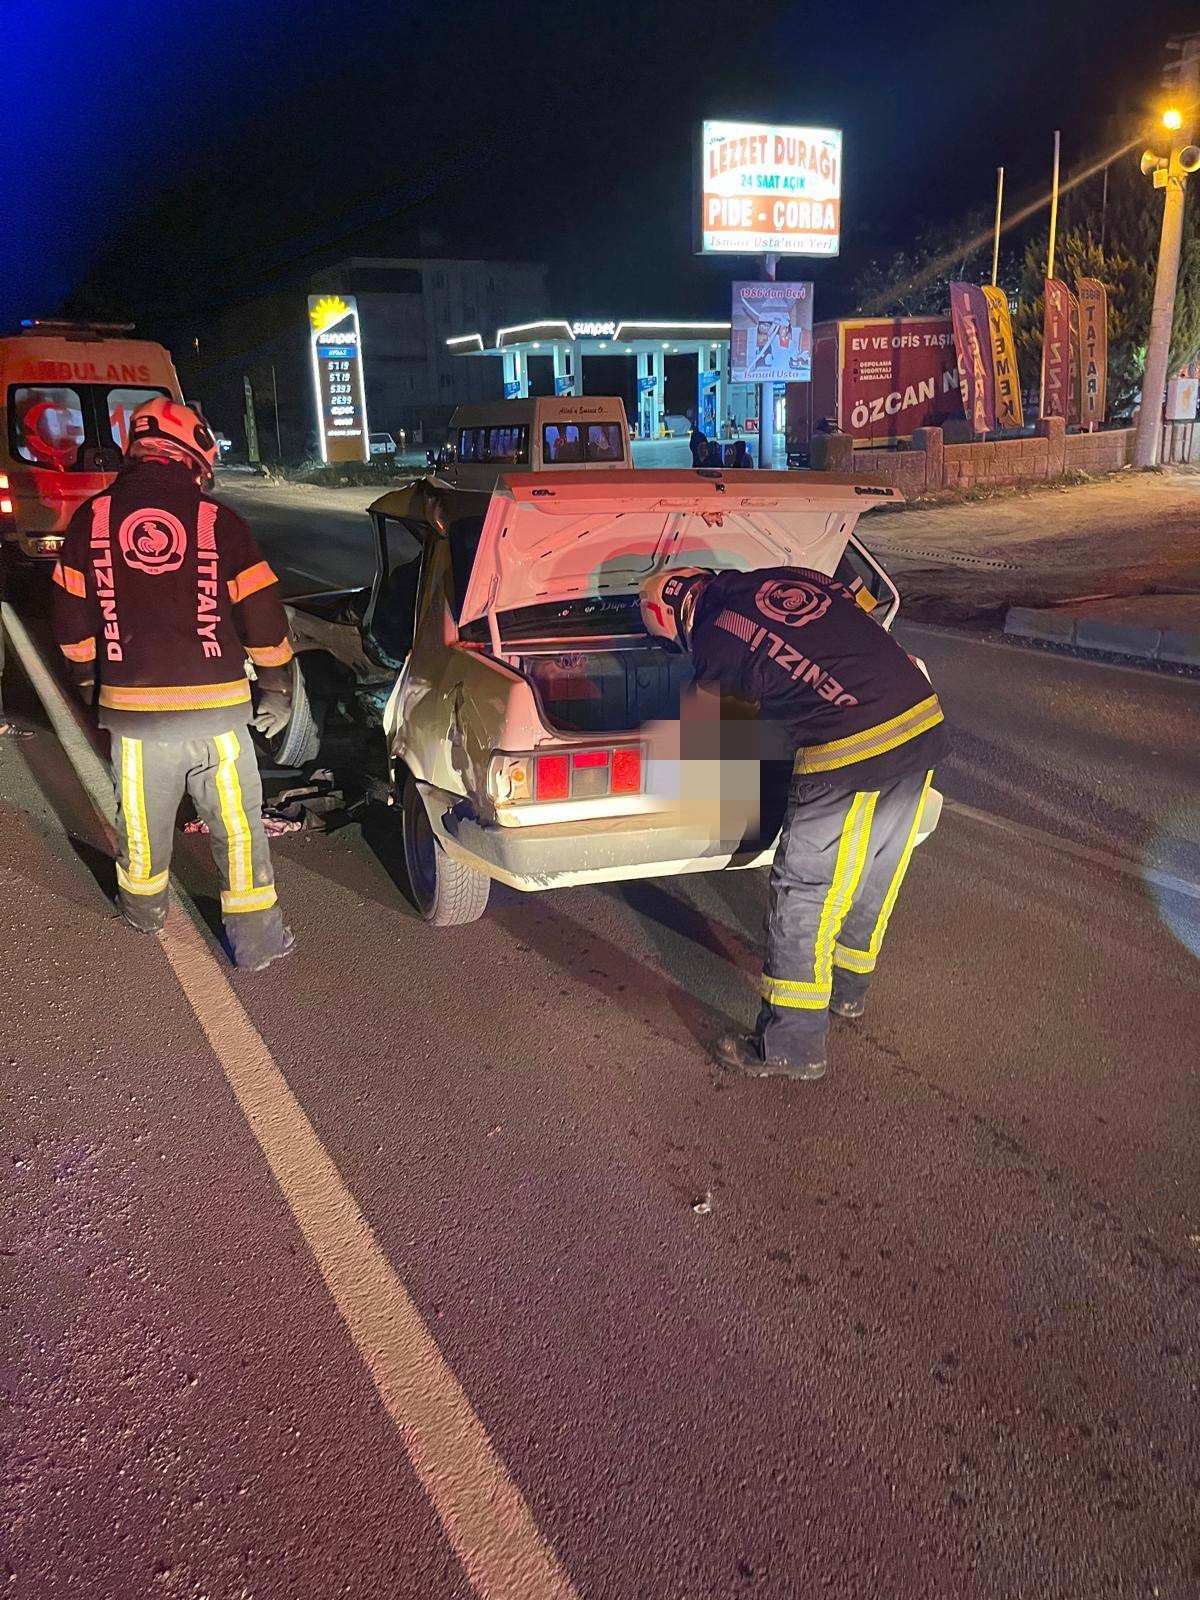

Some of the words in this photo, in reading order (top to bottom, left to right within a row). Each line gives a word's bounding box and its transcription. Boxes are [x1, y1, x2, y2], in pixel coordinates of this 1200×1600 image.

[710, 135, 767, 179] LEZZET
[774, 135, 836, 186] DURAĞI
[741, 174, 753, 187] 24
[756, 174, 780, 188] SAAT
[783, 176, 805, 191] AÇIK
[773, 200, 836, 230] ÇORBA
[786, 288, 806, 299] Beri
[319, 333, 357, 345] sunpet
[573, 322, 616, 337] sunpet
[852, 338, 868, 351] EV
[872, 337, 888, 349] VE
[892, 332, 920, 349] OFİS
[924, 334, 955, 349] TAŞI
[23, 360, 151, 382] AMBULANS
[777, 369, 799, 378] Usta
[851, 377, 935, 429] ÖZCAN
[90, 540, 123, 662] DENİZLİ
[197, 551, 222, 658] İTFAİYE
